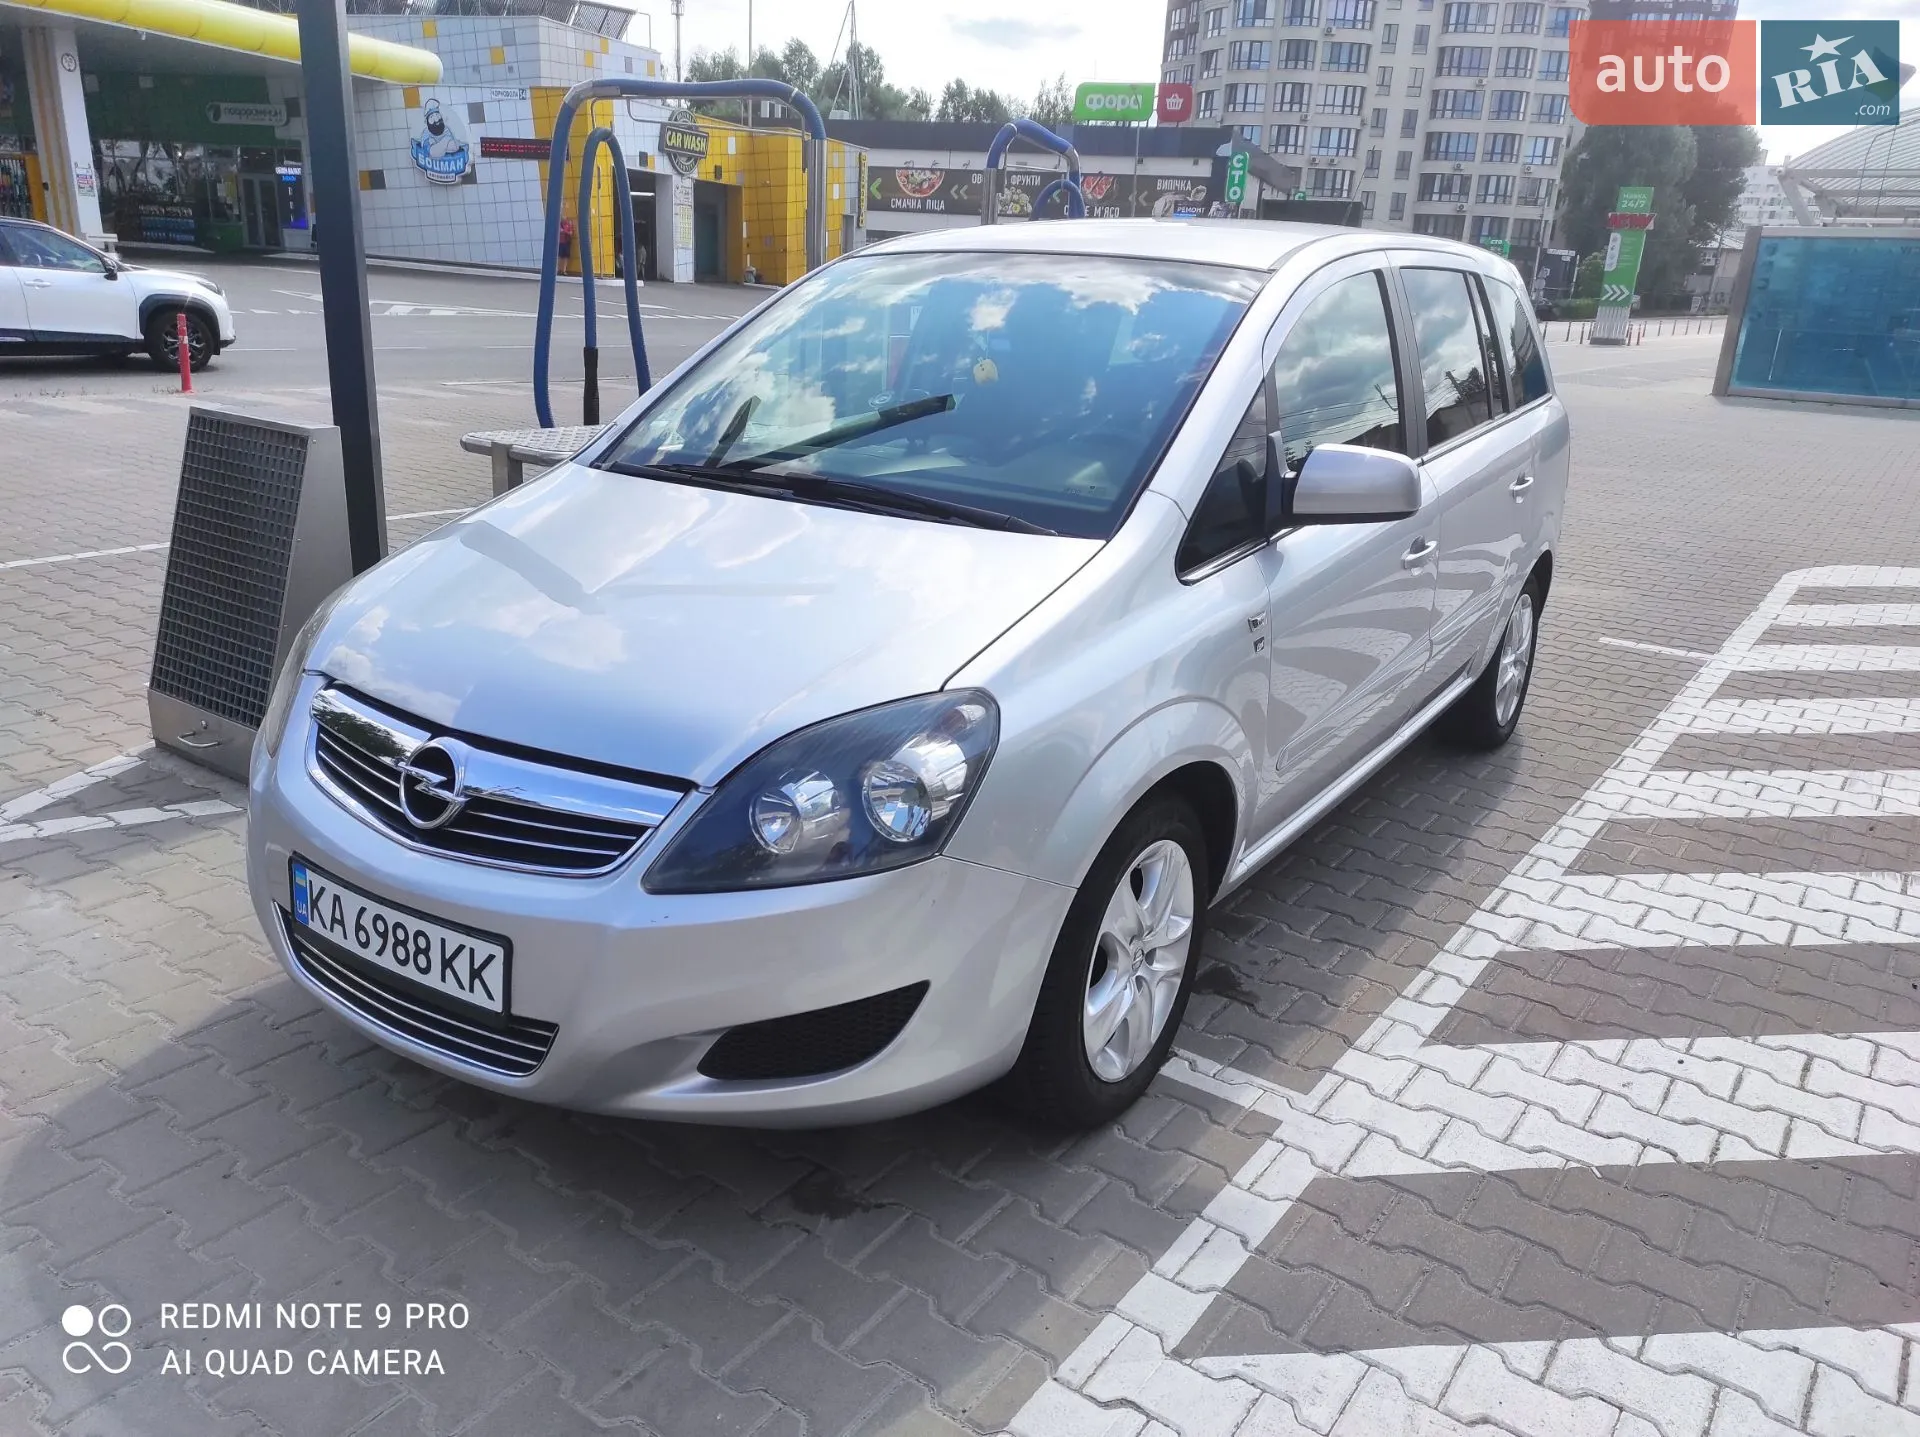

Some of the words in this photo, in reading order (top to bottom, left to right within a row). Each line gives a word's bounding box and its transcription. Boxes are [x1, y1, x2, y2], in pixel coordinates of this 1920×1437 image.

[666, 130, 682, 148] CAR
[683, 133, 707, 152] WASH
[418, 153, 464, 172] БОЦМАН
[1010, 174, 1041, 186] ФРУКТИ
[1229, 153, 1244, 200] СТО
[1156, 178, 1192, 191] ВИПІЧКА
[890, 198, 922, 209] СМАЧНА
[926, 199, 945, 211] ПІЦА
[1177, 206, 1205, 214] РЕМОНТ
[1621, 199, 1646, 209] 24/7
[1093, 205, 1120, 218] М'ЯСО
[296, 900, 308, 918] UA
[308, 879, 348, 941] KA
[354, 906, 432, 976] 6988
[440, 937, 497, 1002] KK
